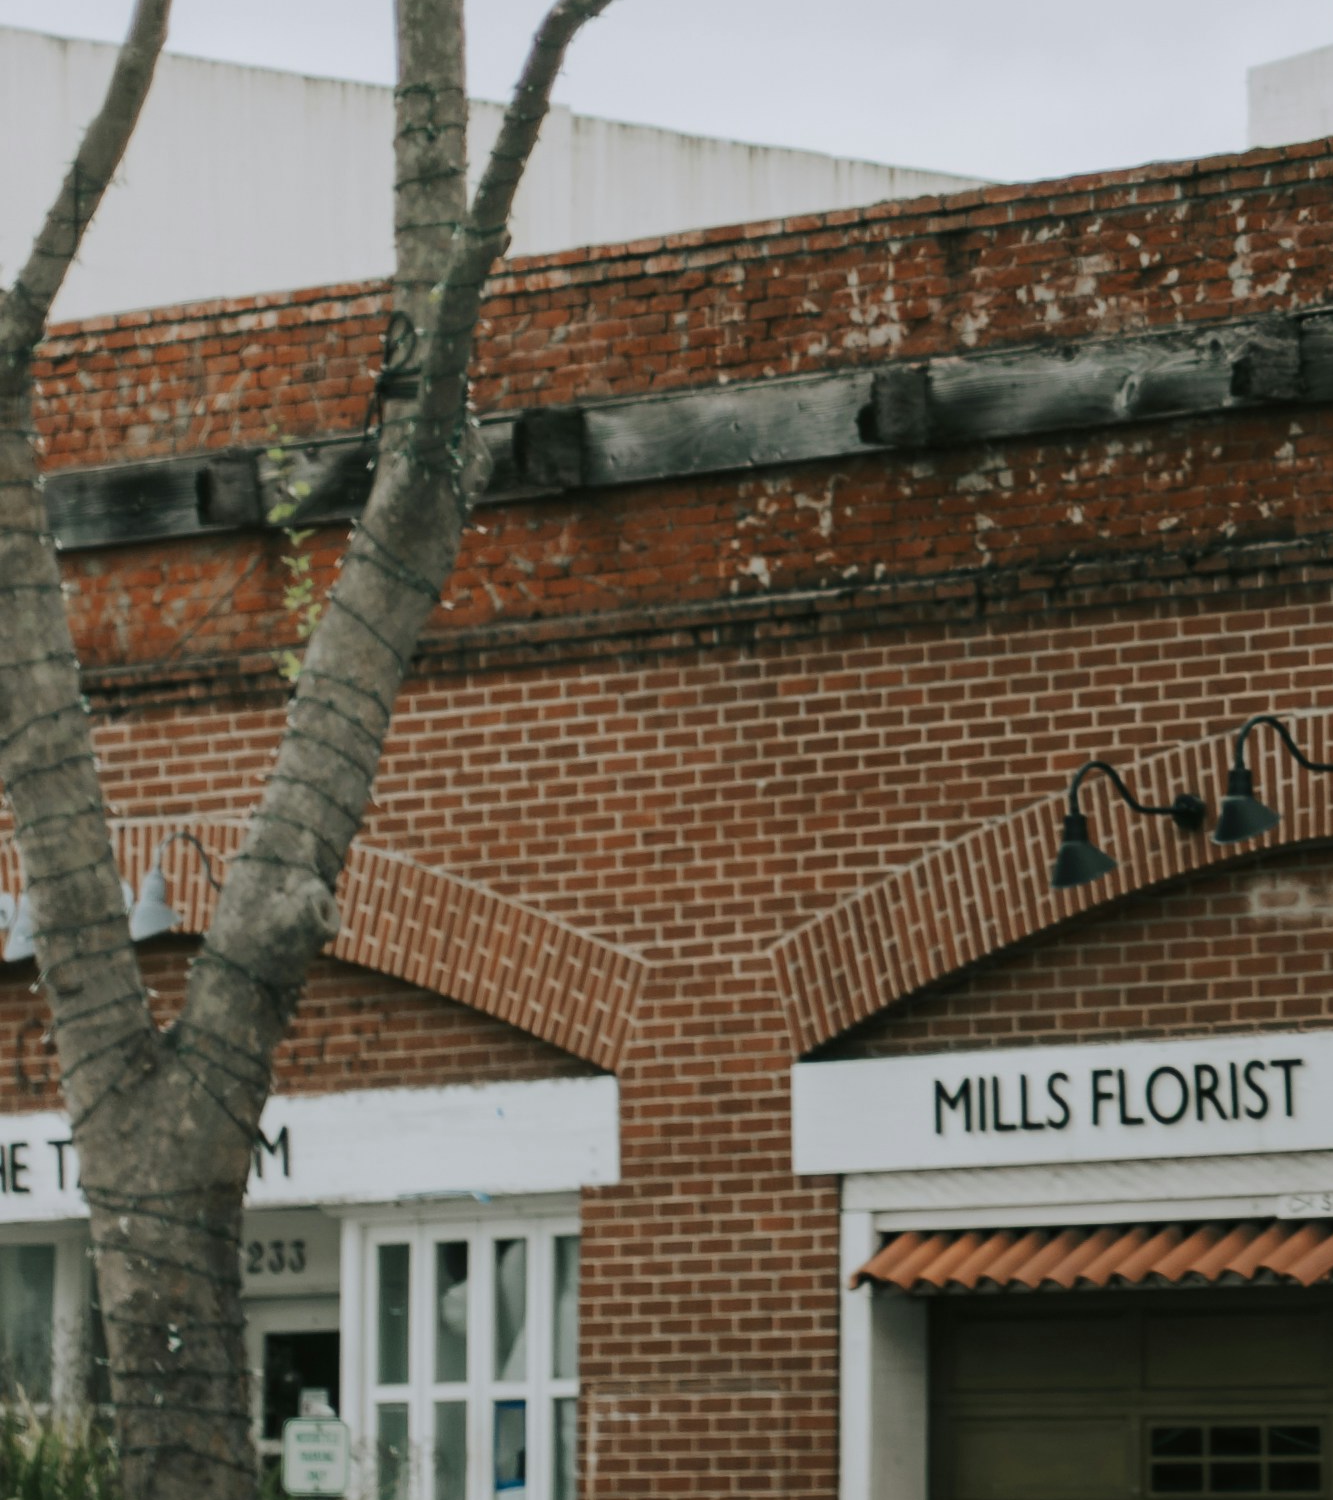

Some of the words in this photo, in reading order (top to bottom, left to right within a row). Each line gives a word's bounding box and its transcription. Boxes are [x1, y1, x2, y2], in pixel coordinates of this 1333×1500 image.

[933, 1072, 1071, 1136] MILLS
[1090, 1057, 1304, 1127] FLORIST
[246, 1239, 307, 1275] 233
